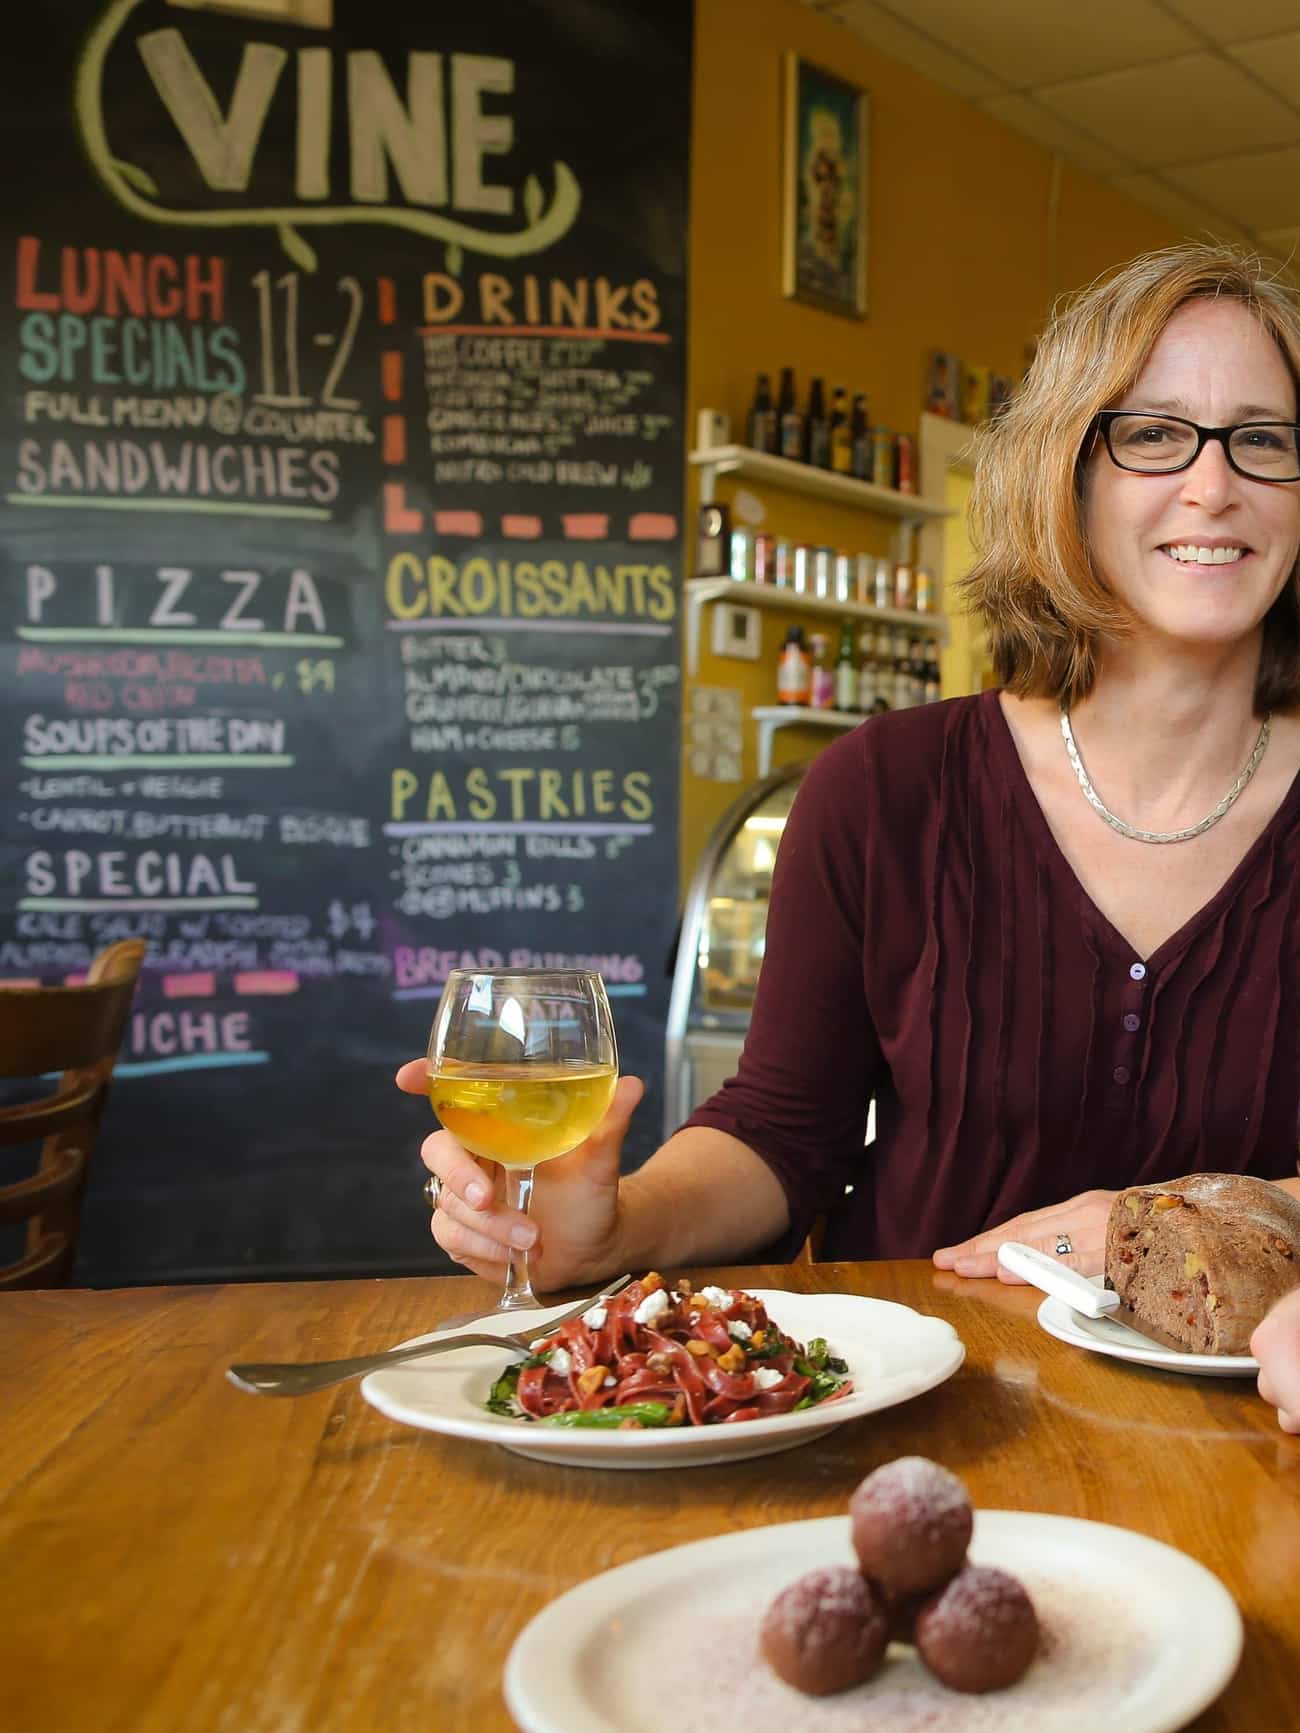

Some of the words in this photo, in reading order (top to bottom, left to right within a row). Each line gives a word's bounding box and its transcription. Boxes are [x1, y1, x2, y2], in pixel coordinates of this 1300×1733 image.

[136, 28, 515, 214] VINE
[16, 236, 224, 321] LUNCH
[423, 272, 661, 331] DRINKS
[19, 312, 248, 395] SPECIALS
[253, 269, 363, 411] 11-2
[24, 391, 108, 425] FULL
[112, 398, 206, 429] MENU
[208, 391, 244, 434] @
[244, 409, 375, 444] COUNTER
[18, 439, 340, 502] SANDWICHES
[27, 566, 327, 632] PIZZA
[386, 552, 676, 621] CROISSANTS
[24, 713, 134, 757] SOUPS
[136, 719, 174, 752] OF
[175, 719, 224, 753] THE
[228, 719, 285, 753] DAY
[391, 767, 654, 821] PASTRIES
[26, 850, 257, 896] SPECIAL
[132, 1012, 251, 1053] ICHE
